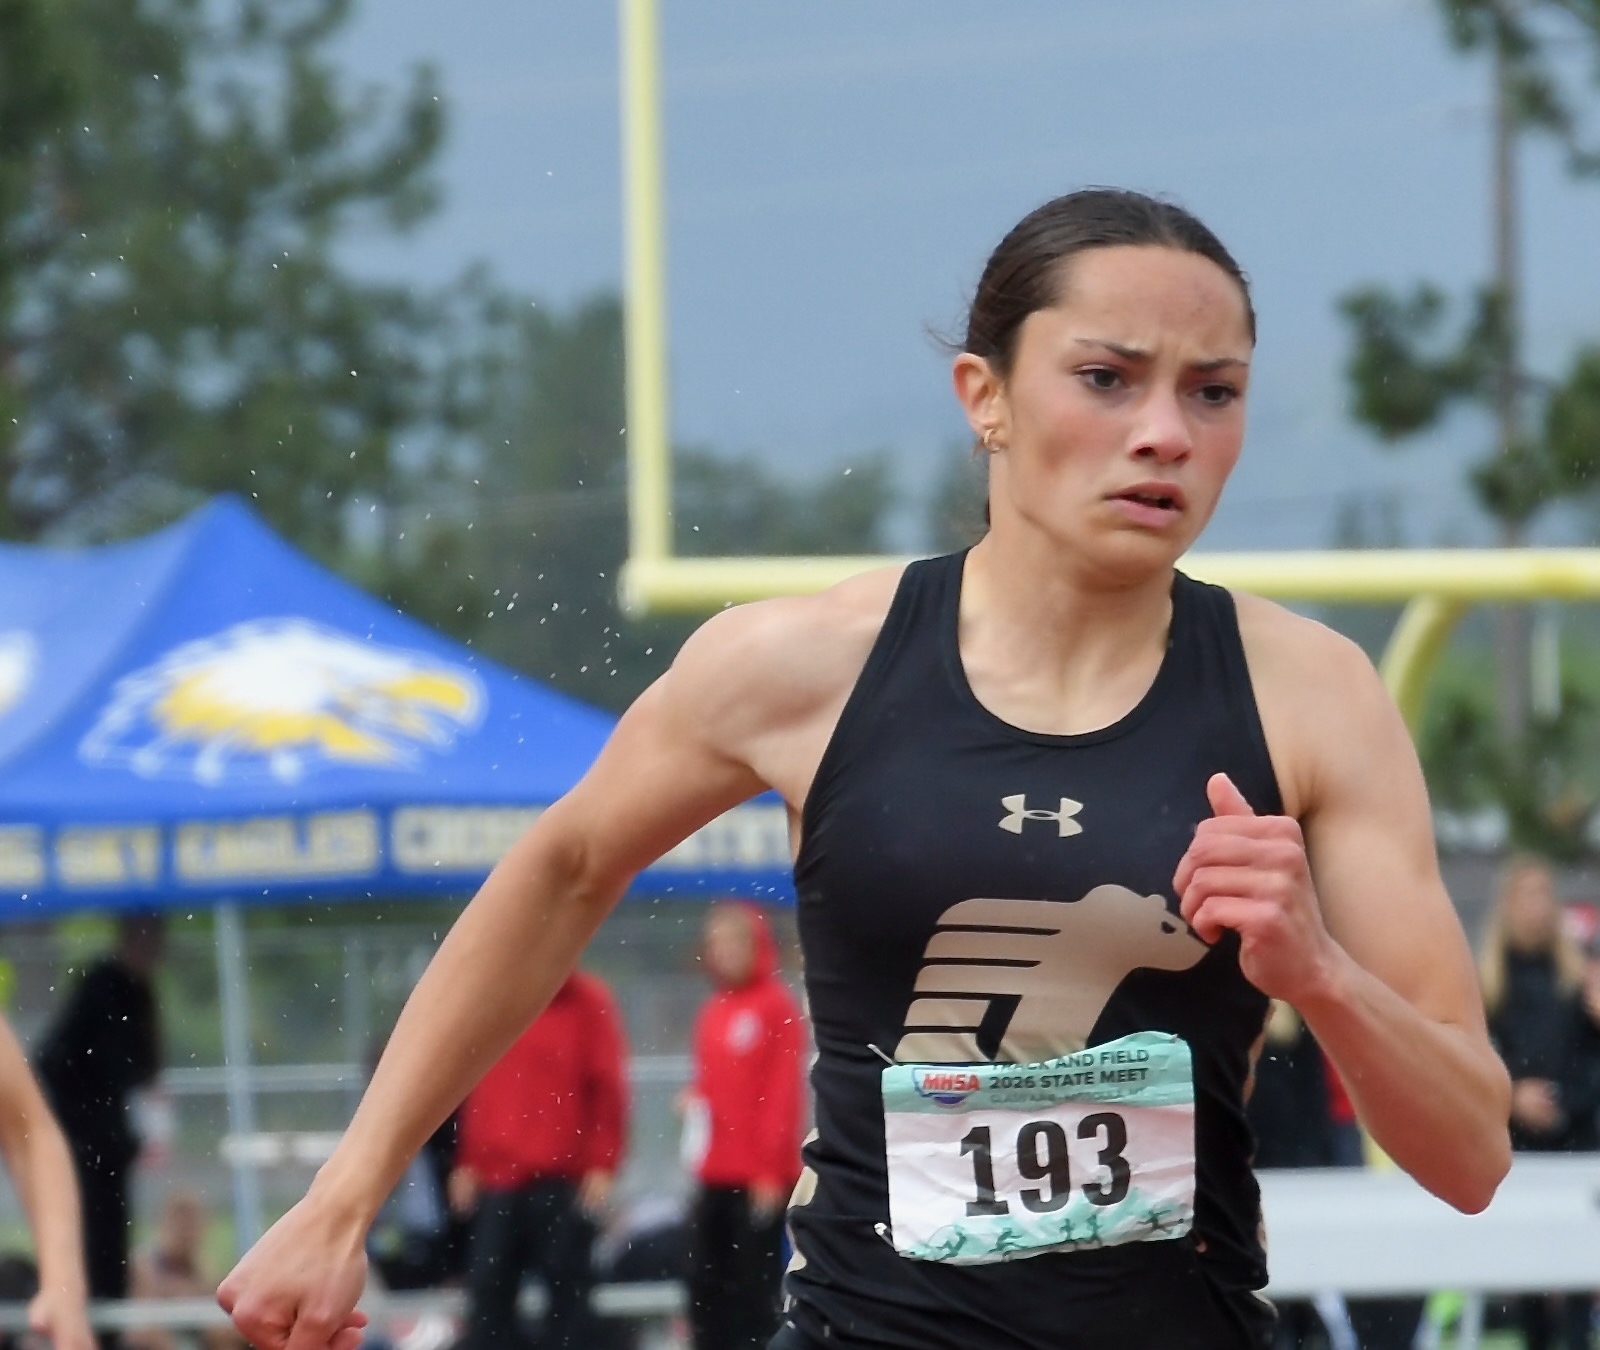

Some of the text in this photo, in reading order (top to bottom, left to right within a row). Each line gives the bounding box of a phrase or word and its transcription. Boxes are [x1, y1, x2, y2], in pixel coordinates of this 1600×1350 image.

[174, 810, 379, 882] EAGLES
[1055, 1053, 1095, 1069] AND
[1100, 1049, 1150, 1065] FIELD
[922, 1073, 981, 1092] MHSA
[989, 1067, 1149, 1090] 2026 STATE MEET
[960, 1112, 1131, 1217] 193
